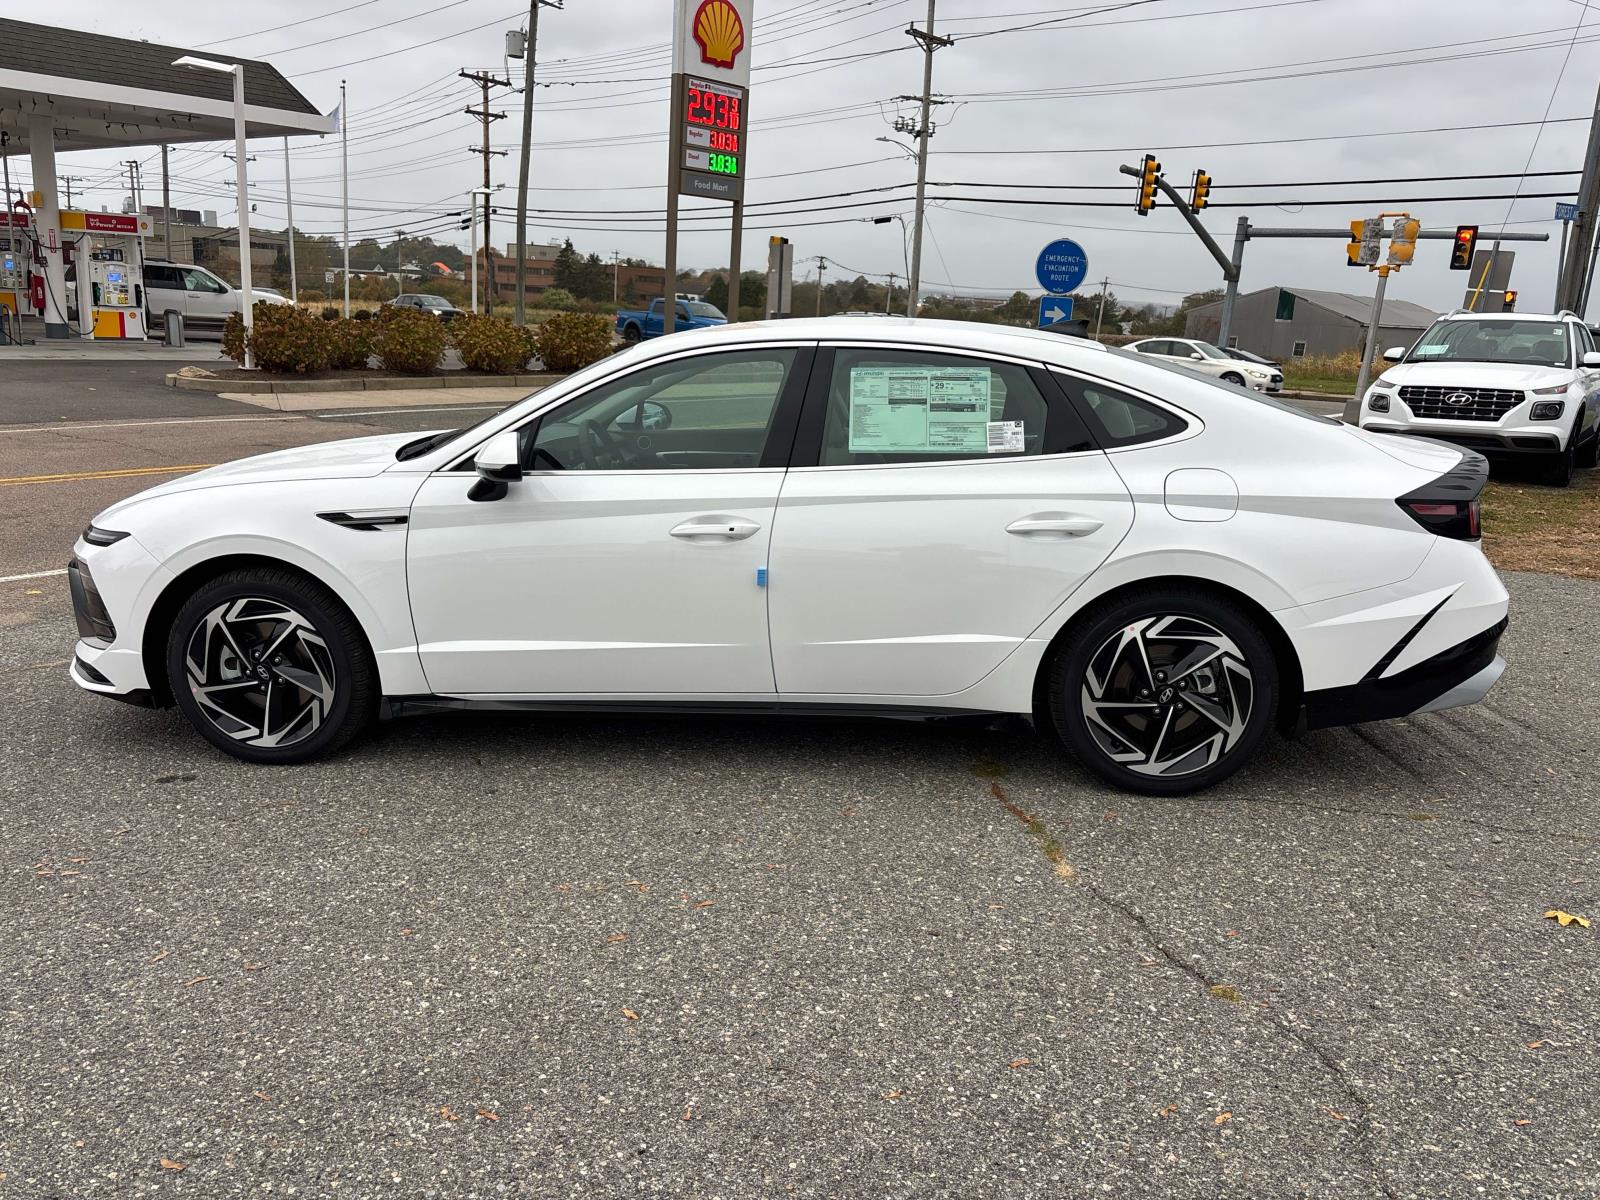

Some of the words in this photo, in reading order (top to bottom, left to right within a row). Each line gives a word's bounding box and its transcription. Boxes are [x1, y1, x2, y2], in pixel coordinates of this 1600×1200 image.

[688, 89, 729, 128] 2.93
[688, 130, 704, 138] Regular
[710, 130, 732, 151] 3.03
[688, 153, 700, 161] Diesel
[694, 180, 711, 190] Food
[712, 182, 729, 192] Mart
[1045, 254, 1080, 263] EMERGENCY
[1044, 264, 1079, 272] EVACUATION
[935, 382, 945, 390] 29
